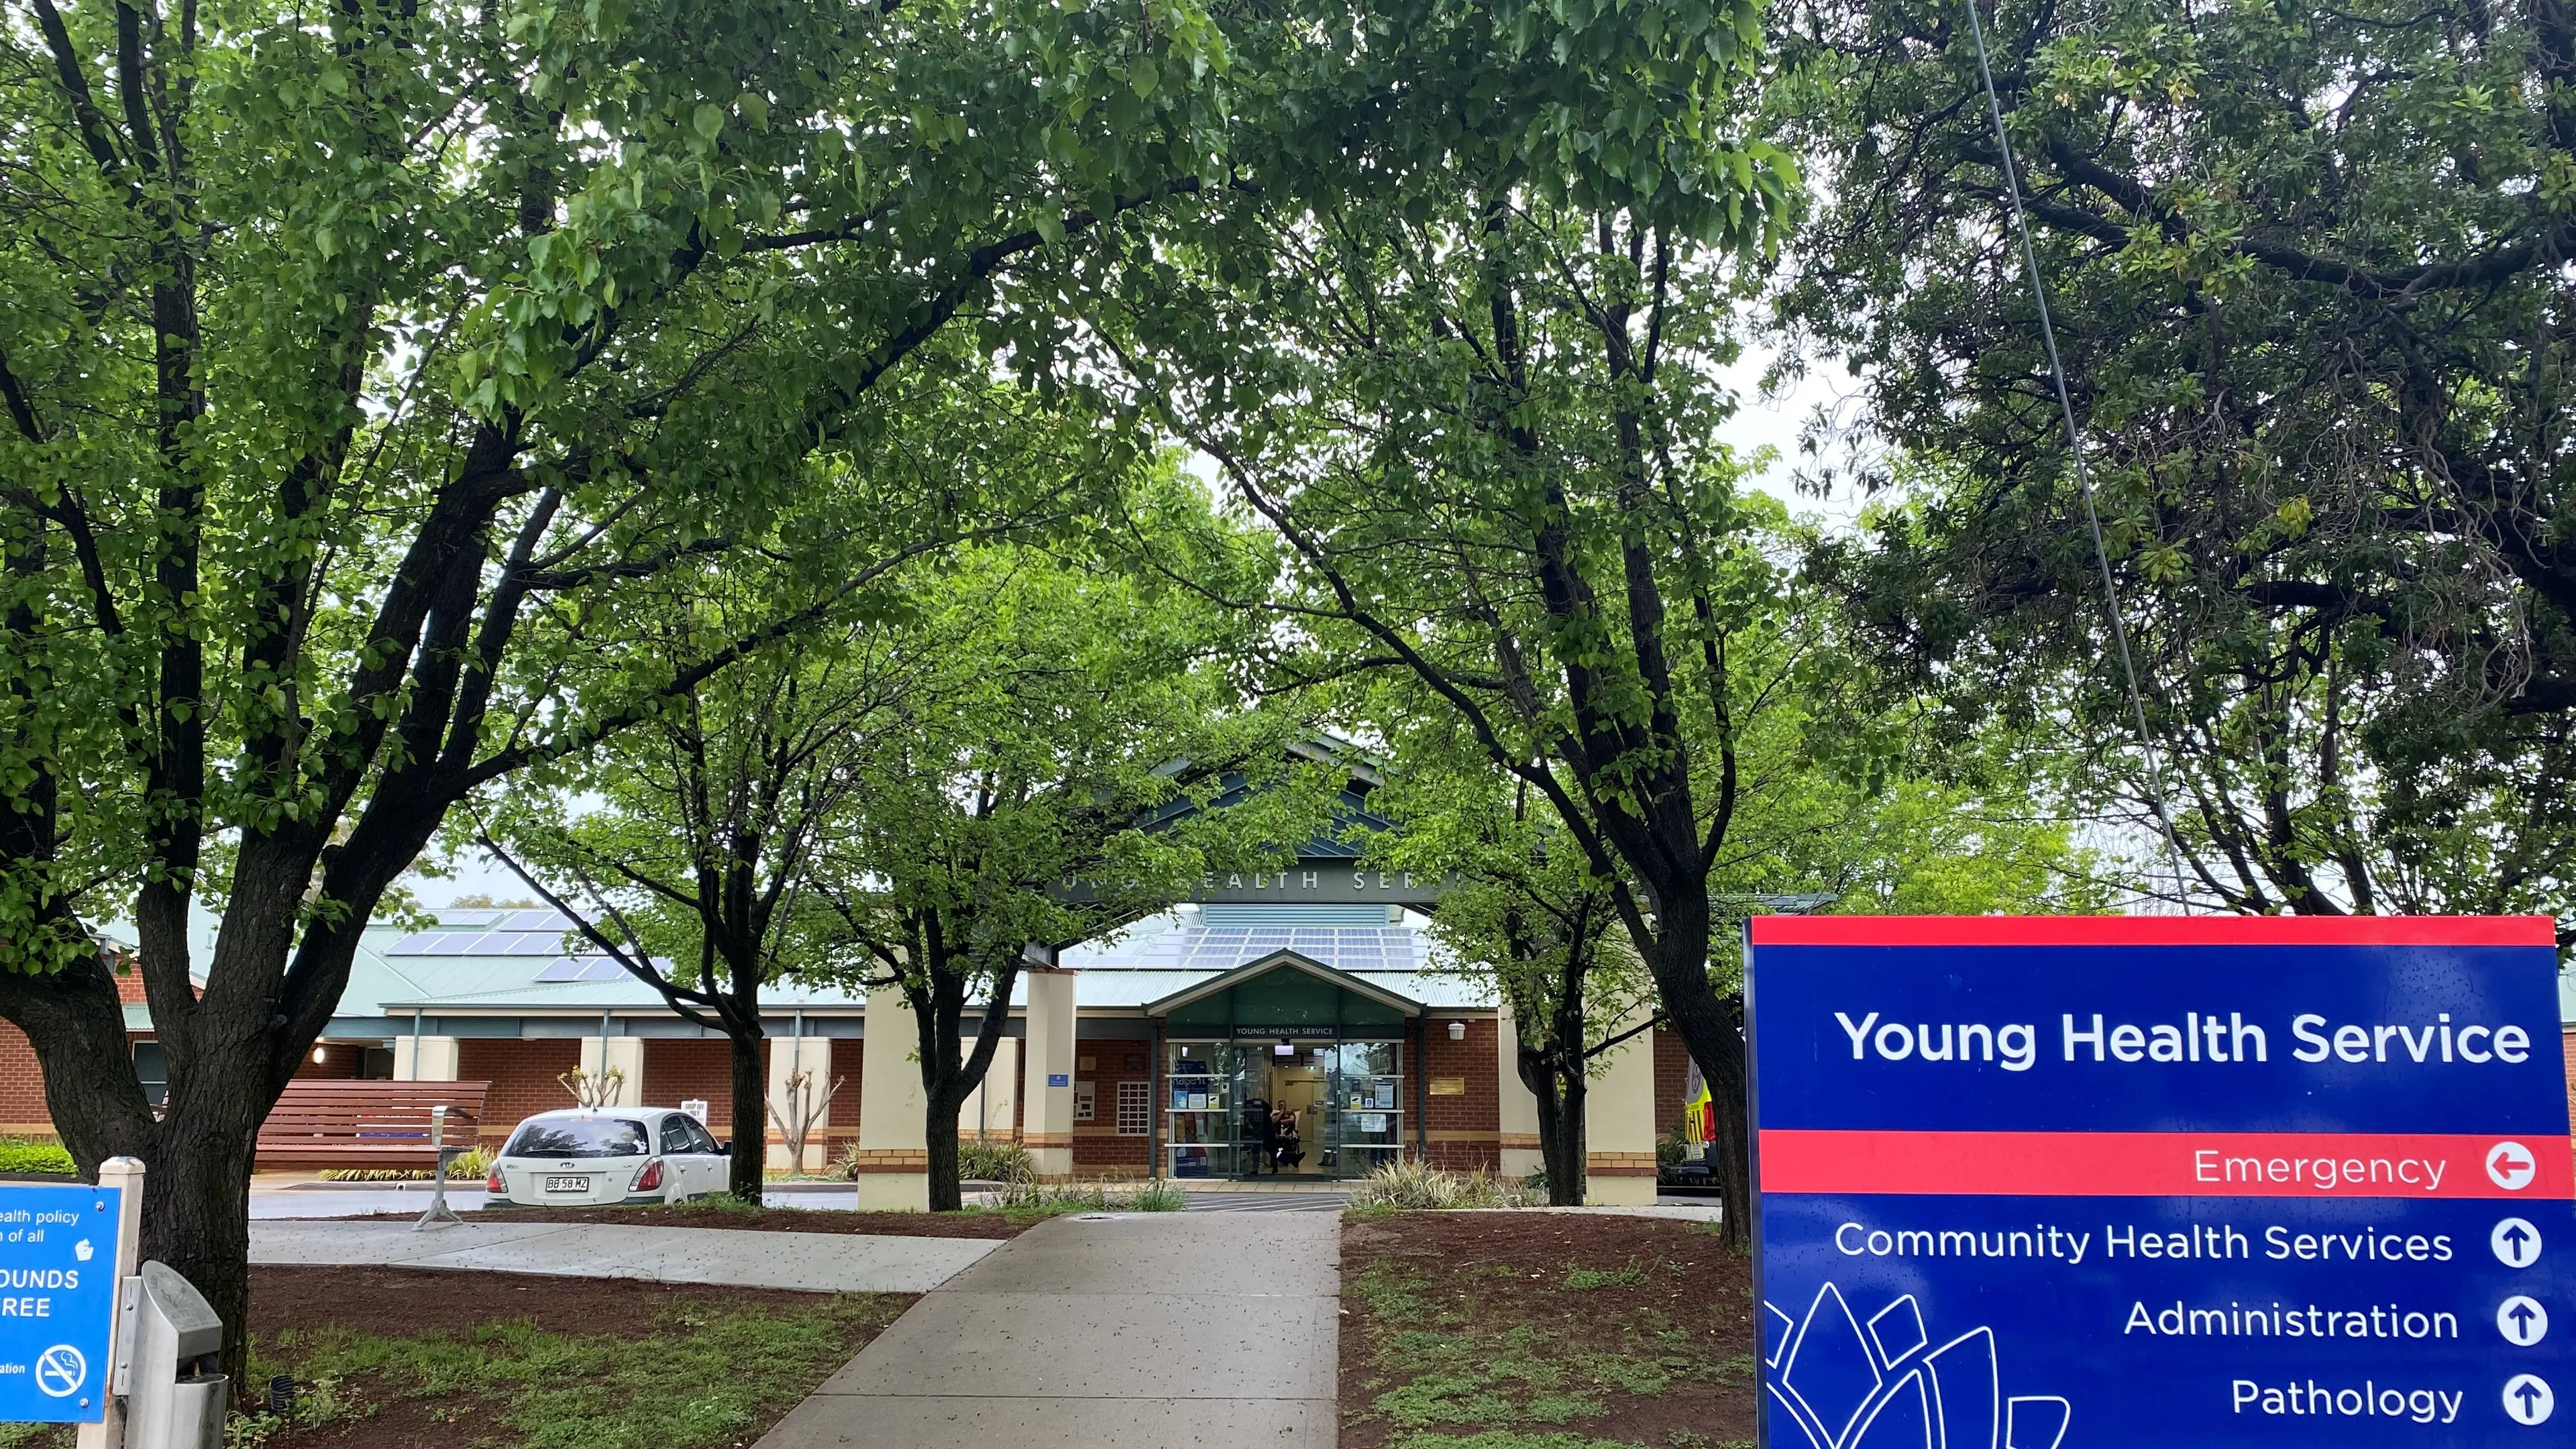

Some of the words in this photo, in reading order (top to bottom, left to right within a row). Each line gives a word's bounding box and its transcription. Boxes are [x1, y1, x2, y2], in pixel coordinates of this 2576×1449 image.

[1203, 871, 1318, 890] EALTH
[1834, 1012, 2036, 1071] Young
[2062, 1012, 2267, 1063] Health
[2292, 1012, 2531, 1064] Service
[563, 1179, 573, 1189] 58
[2194, 1149, 2447, 1191] Emergency
[36, 1210, 80, 1227] policy
[8, 1229, 24, 1242] of
[27, 1229, 45, 1242] all
[1835, 1221, 2091, 1265] Community
[2106, 1223, 2250, 1260] Health
[2264, 1225, 2455, 1263] Services
[0, 1297, 51, 1318] REE
[2123, 1300, 2459, 1340] Administration
[2232, 1379, 2464, 1424] Pathology
